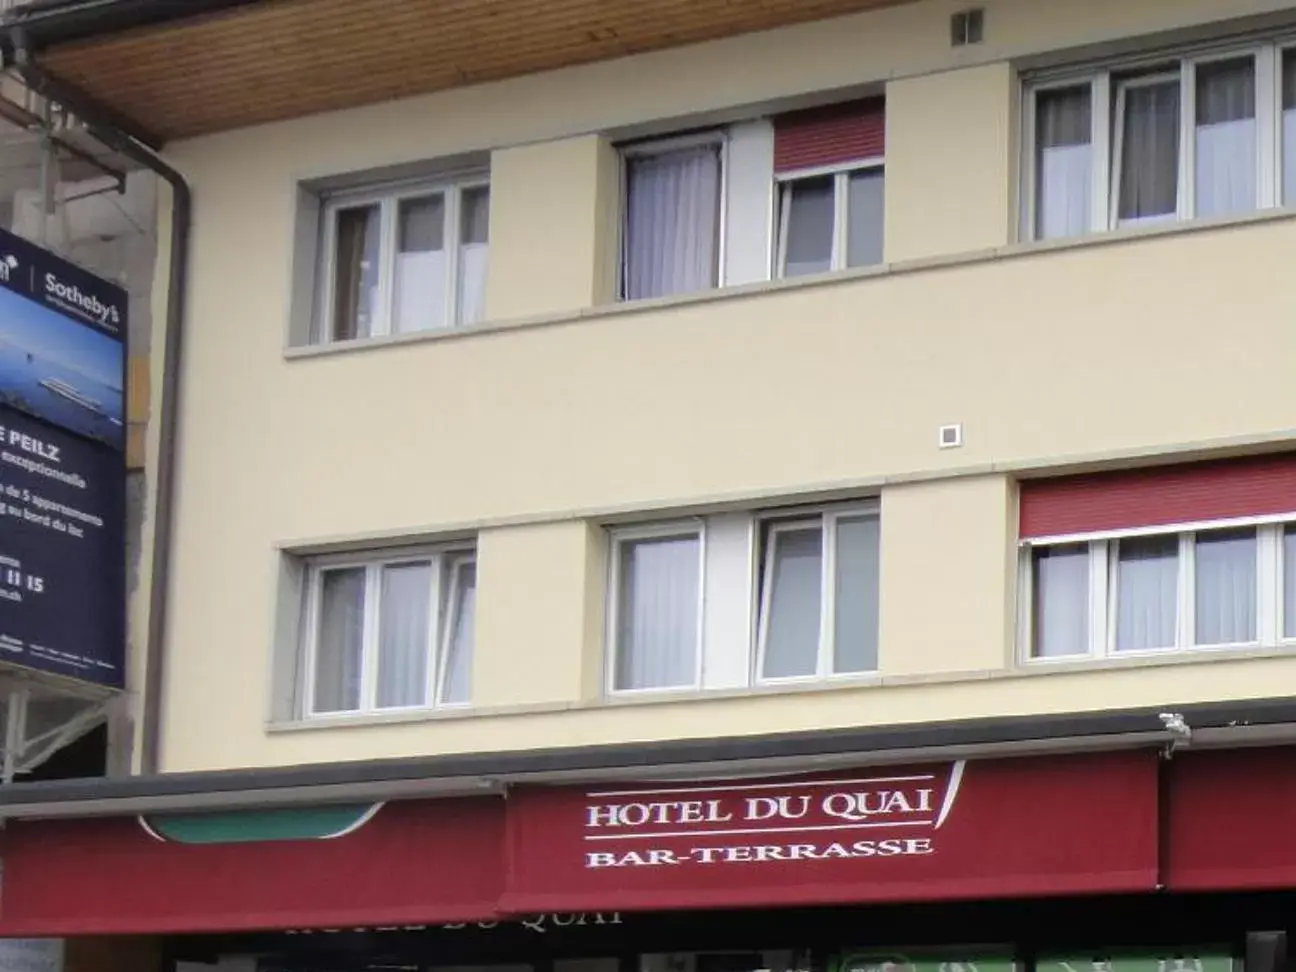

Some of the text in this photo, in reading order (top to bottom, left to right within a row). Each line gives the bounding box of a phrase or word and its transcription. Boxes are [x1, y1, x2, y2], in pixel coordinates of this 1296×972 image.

[9, 429, 61, 463] PEILZ
[27, 574, 44, 593] 15
[586, 787, 934, 828] HOTEL DU QUAI
[584, 837, 936, 868] BAR-TERRASSE
